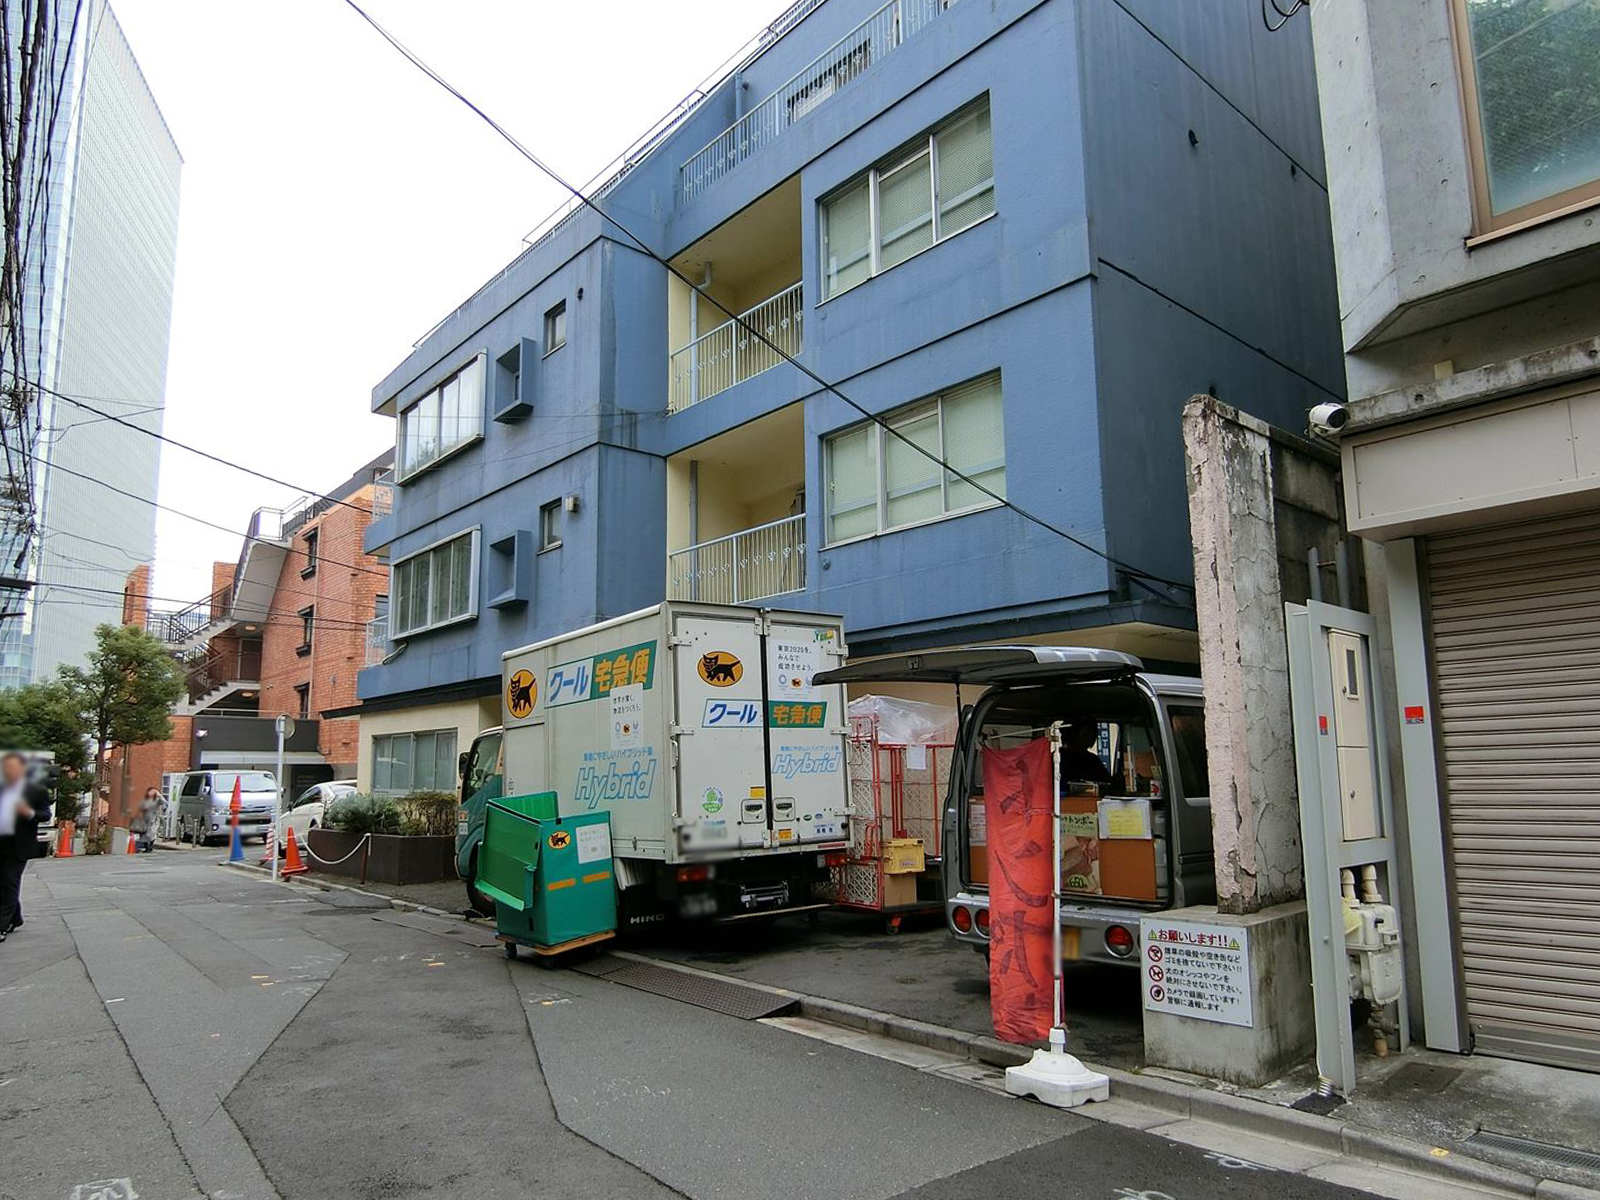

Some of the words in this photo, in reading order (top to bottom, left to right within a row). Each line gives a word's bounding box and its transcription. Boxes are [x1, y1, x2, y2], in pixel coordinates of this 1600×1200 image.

[550, 665, 588, 702] クール
[595, 648, 650, 692] 宅急便
[709, 703, 757, 724] クール
[772, 704, 823, 725] 宅急便
[772, 751, 841, 779] Hybrid
[574, 758, 658, 810] Hybrid
[630, 912, 665, 925] HINO
